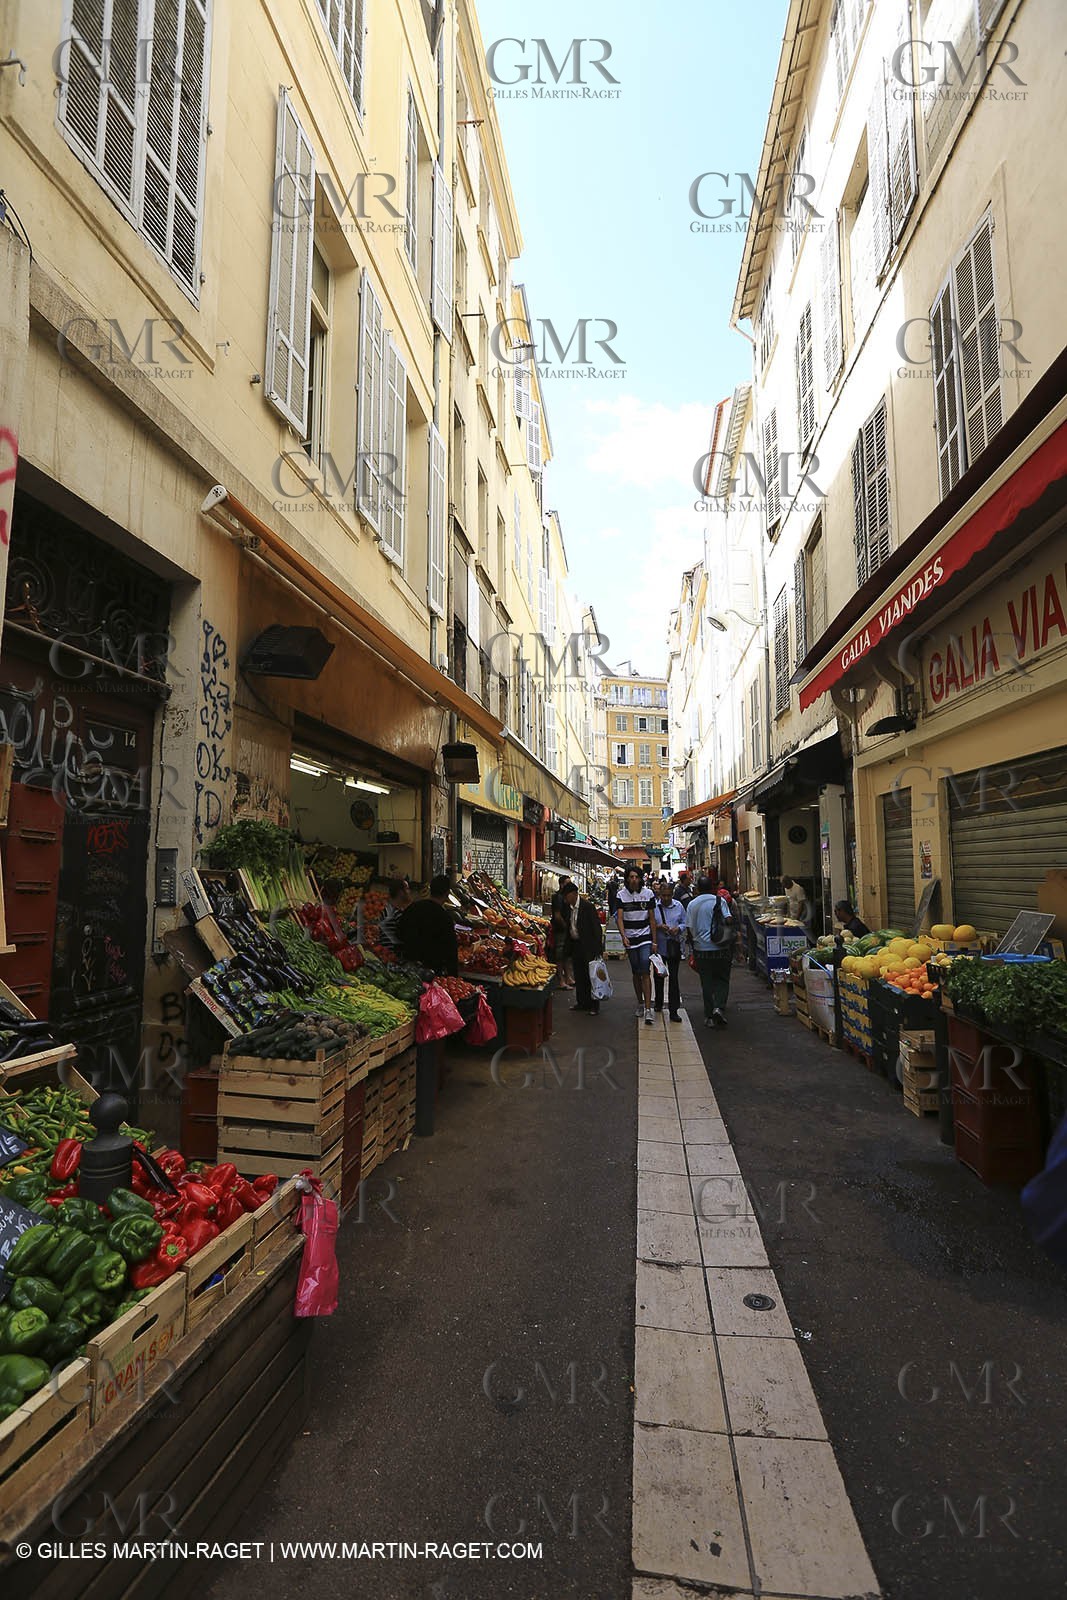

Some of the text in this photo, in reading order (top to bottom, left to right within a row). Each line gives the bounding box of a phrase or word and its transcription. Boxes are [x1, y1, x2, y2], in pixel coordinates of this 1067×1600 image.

[840, 556, 945, 669] GALIA VIANDES
[929, 562, 1067, 704] GALIA VIA
[124, 732, 136, 748] 14
[782, 938, 806, 948] Lyca
